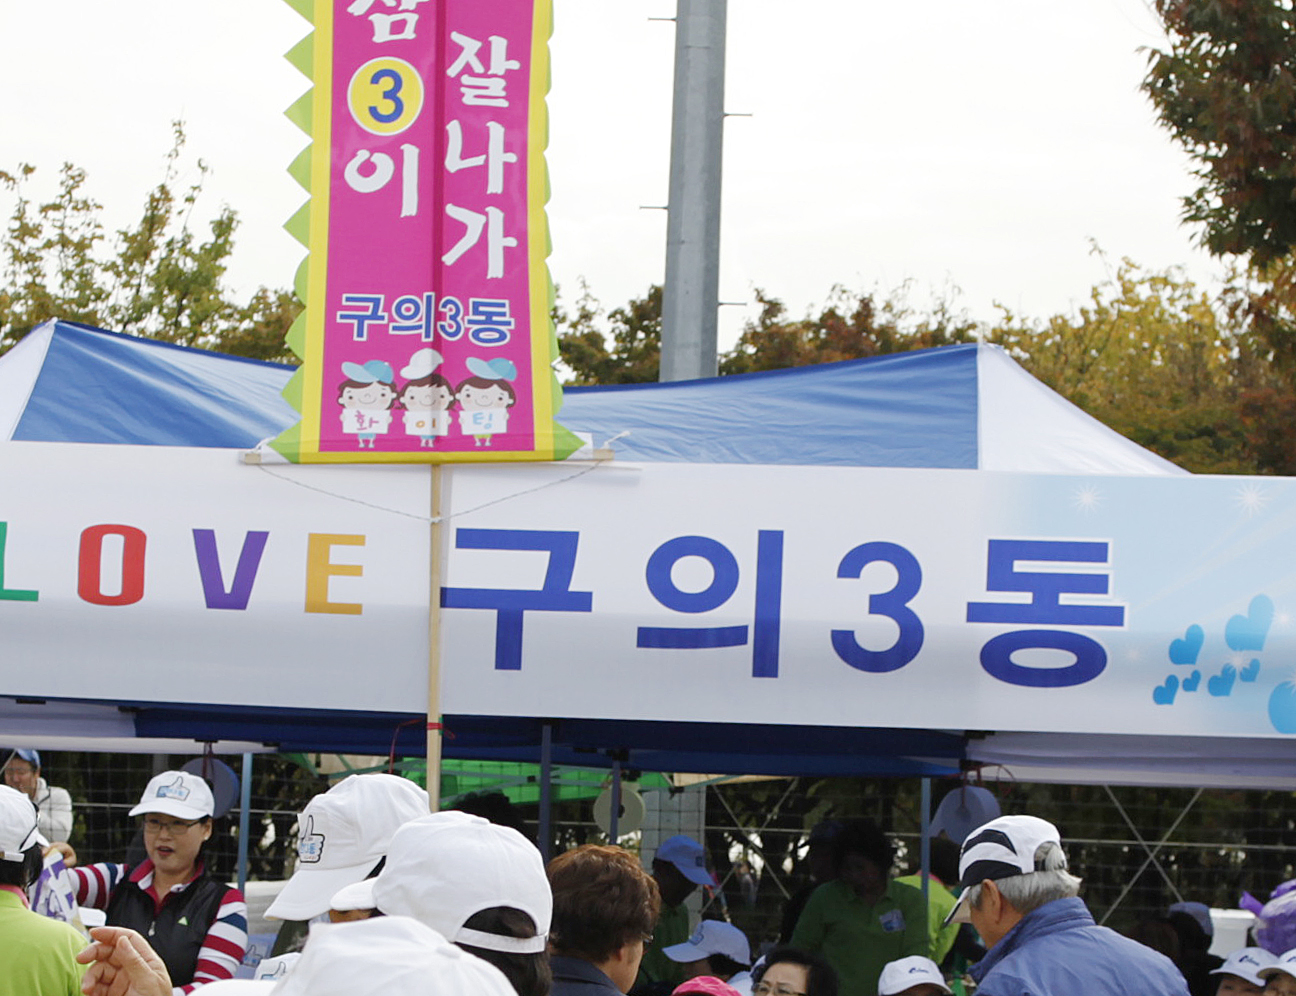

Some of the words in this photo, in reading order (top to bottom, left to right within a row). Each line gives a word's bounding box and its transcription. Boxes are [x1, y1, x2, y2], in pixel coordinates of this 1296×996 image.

[441, 31, 521, 279] 잘나가
[337, 292, 515, 347] 구의3동
[440, 528, 1126, 689] 구의3동
